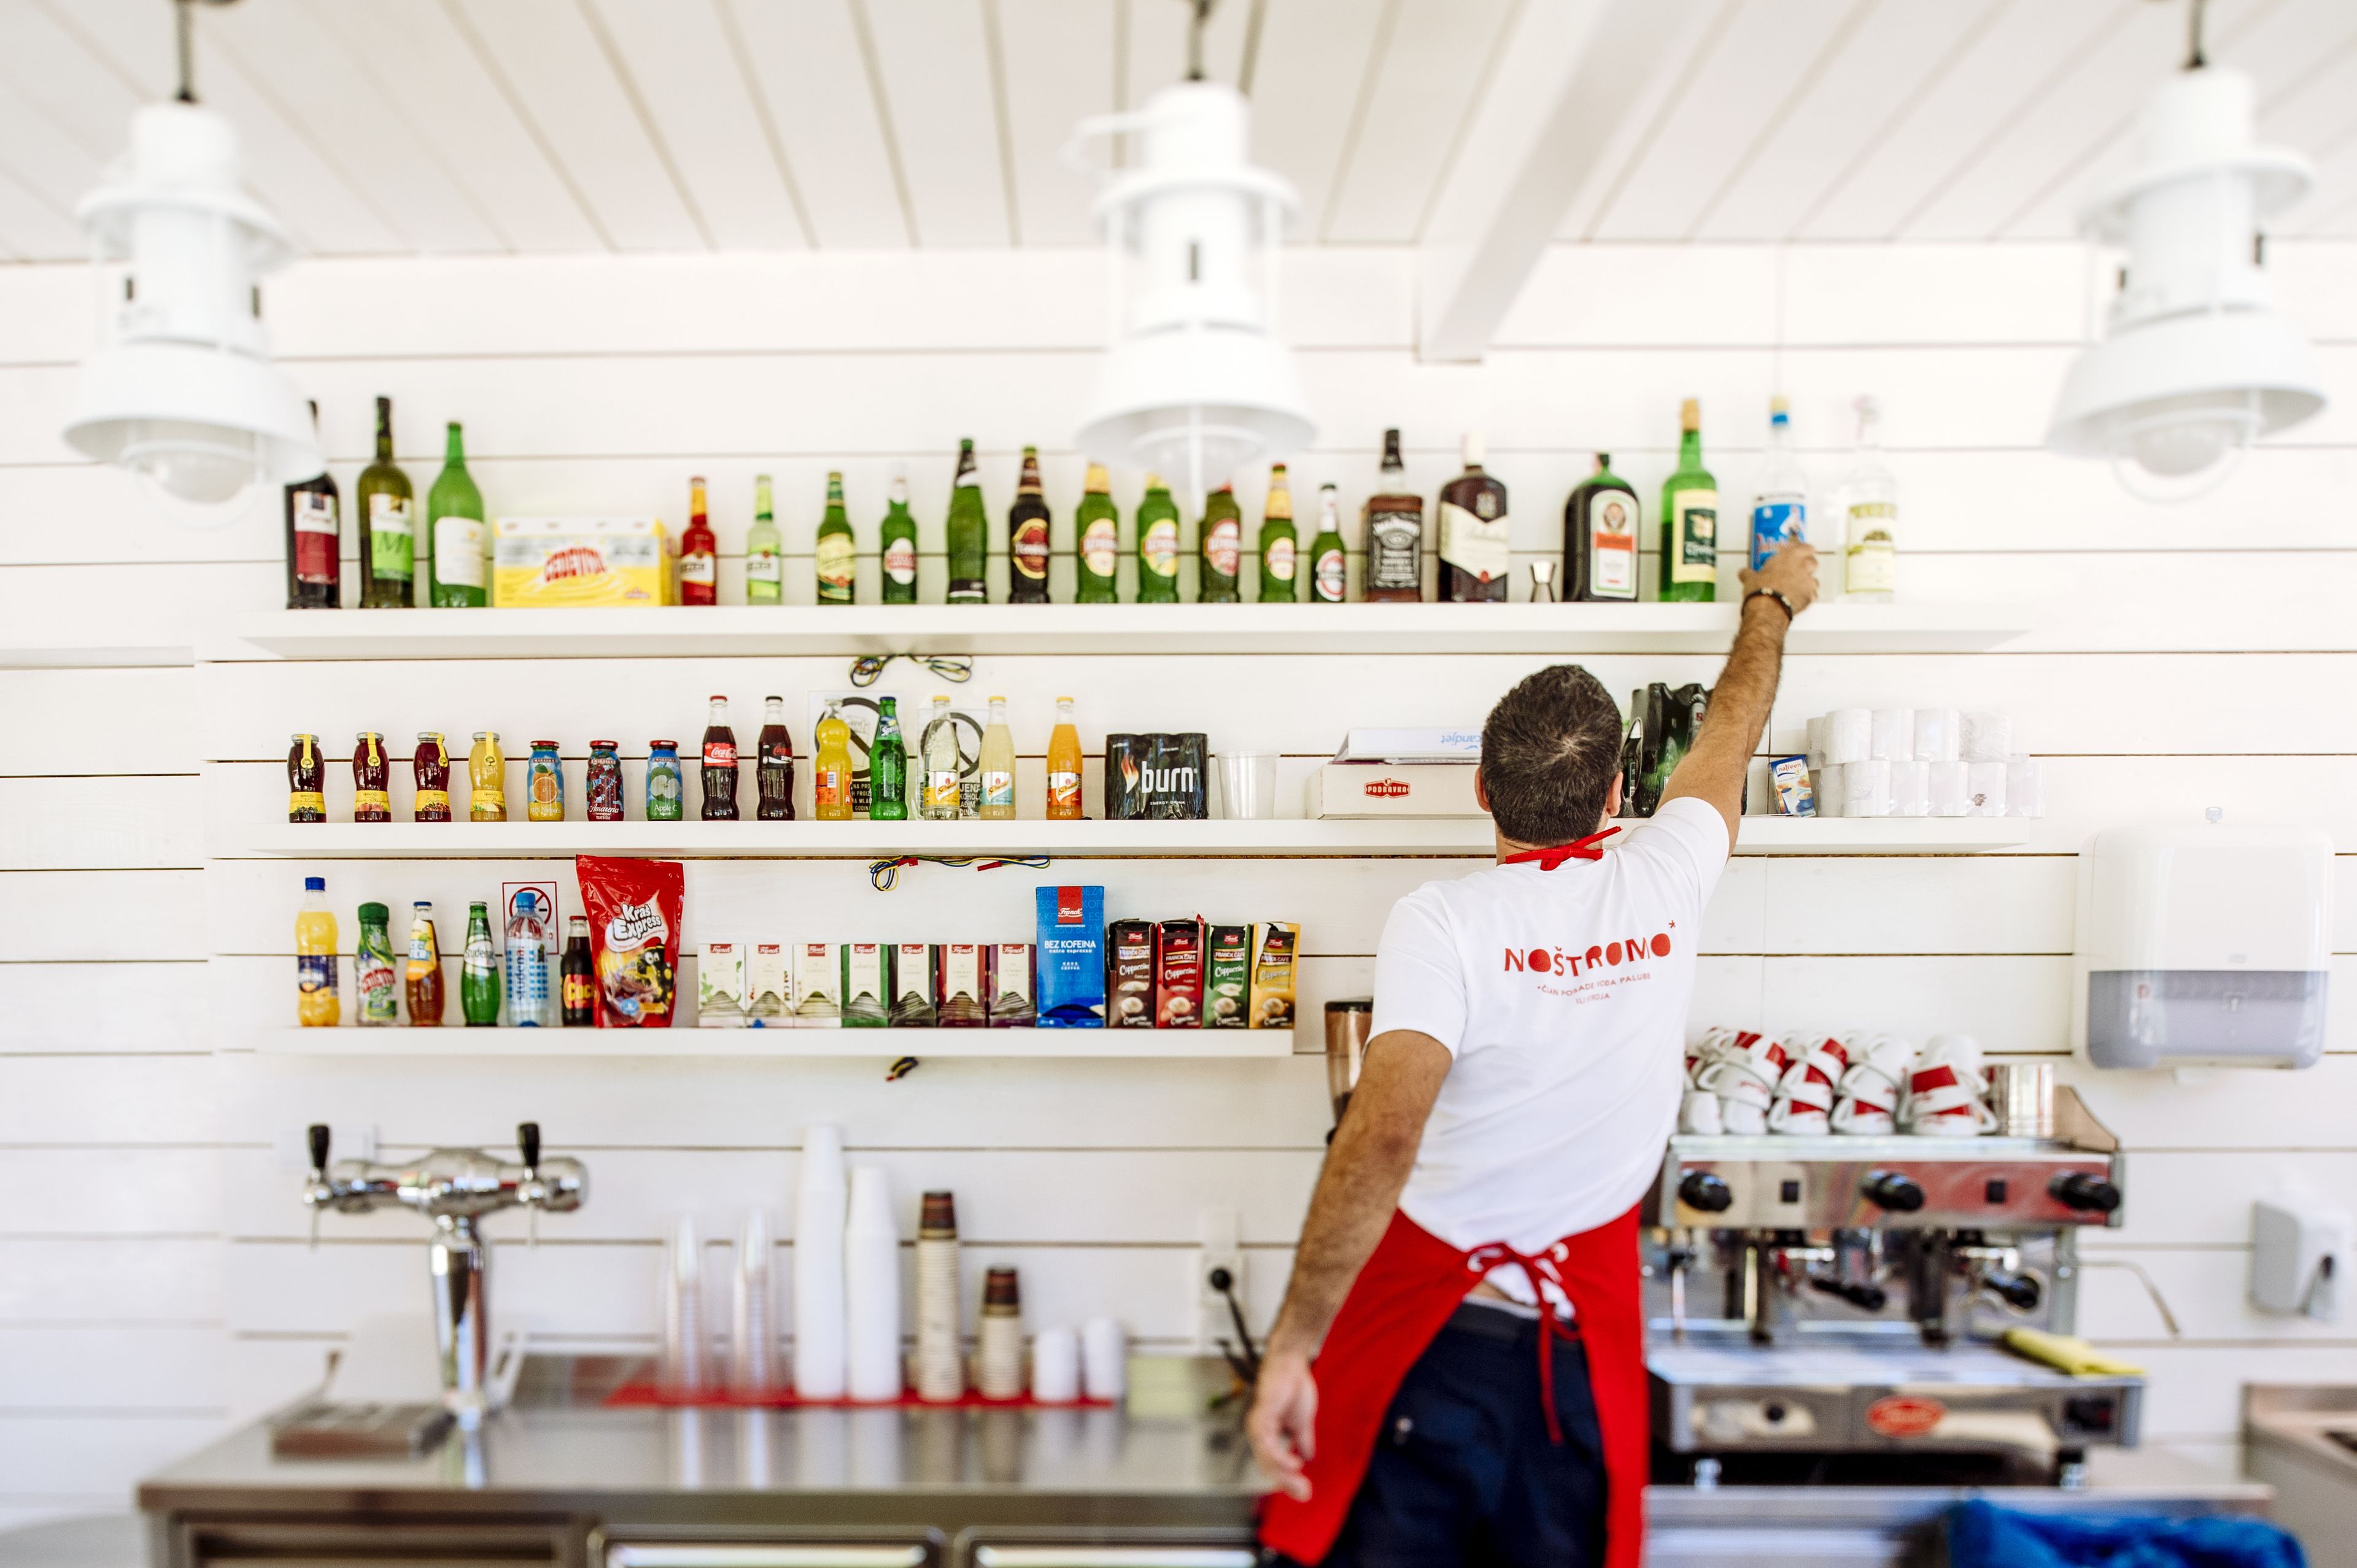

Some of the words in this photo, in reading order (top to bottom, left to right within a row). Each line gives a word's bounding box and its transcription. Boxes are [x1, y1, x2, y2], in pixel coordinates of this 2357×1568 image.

[1142, 760, 1193, 794] burn
[654, 805, 672, 813] Apple
[1058, 908, 1082, 917] Franck
[613, 916, 662, 941] Express
[1044, 940, 1059, 949] BEZ
[1061, 940, 1097, 949] KOFEINA
[1619, 972, 1651, 984] PALUBE
